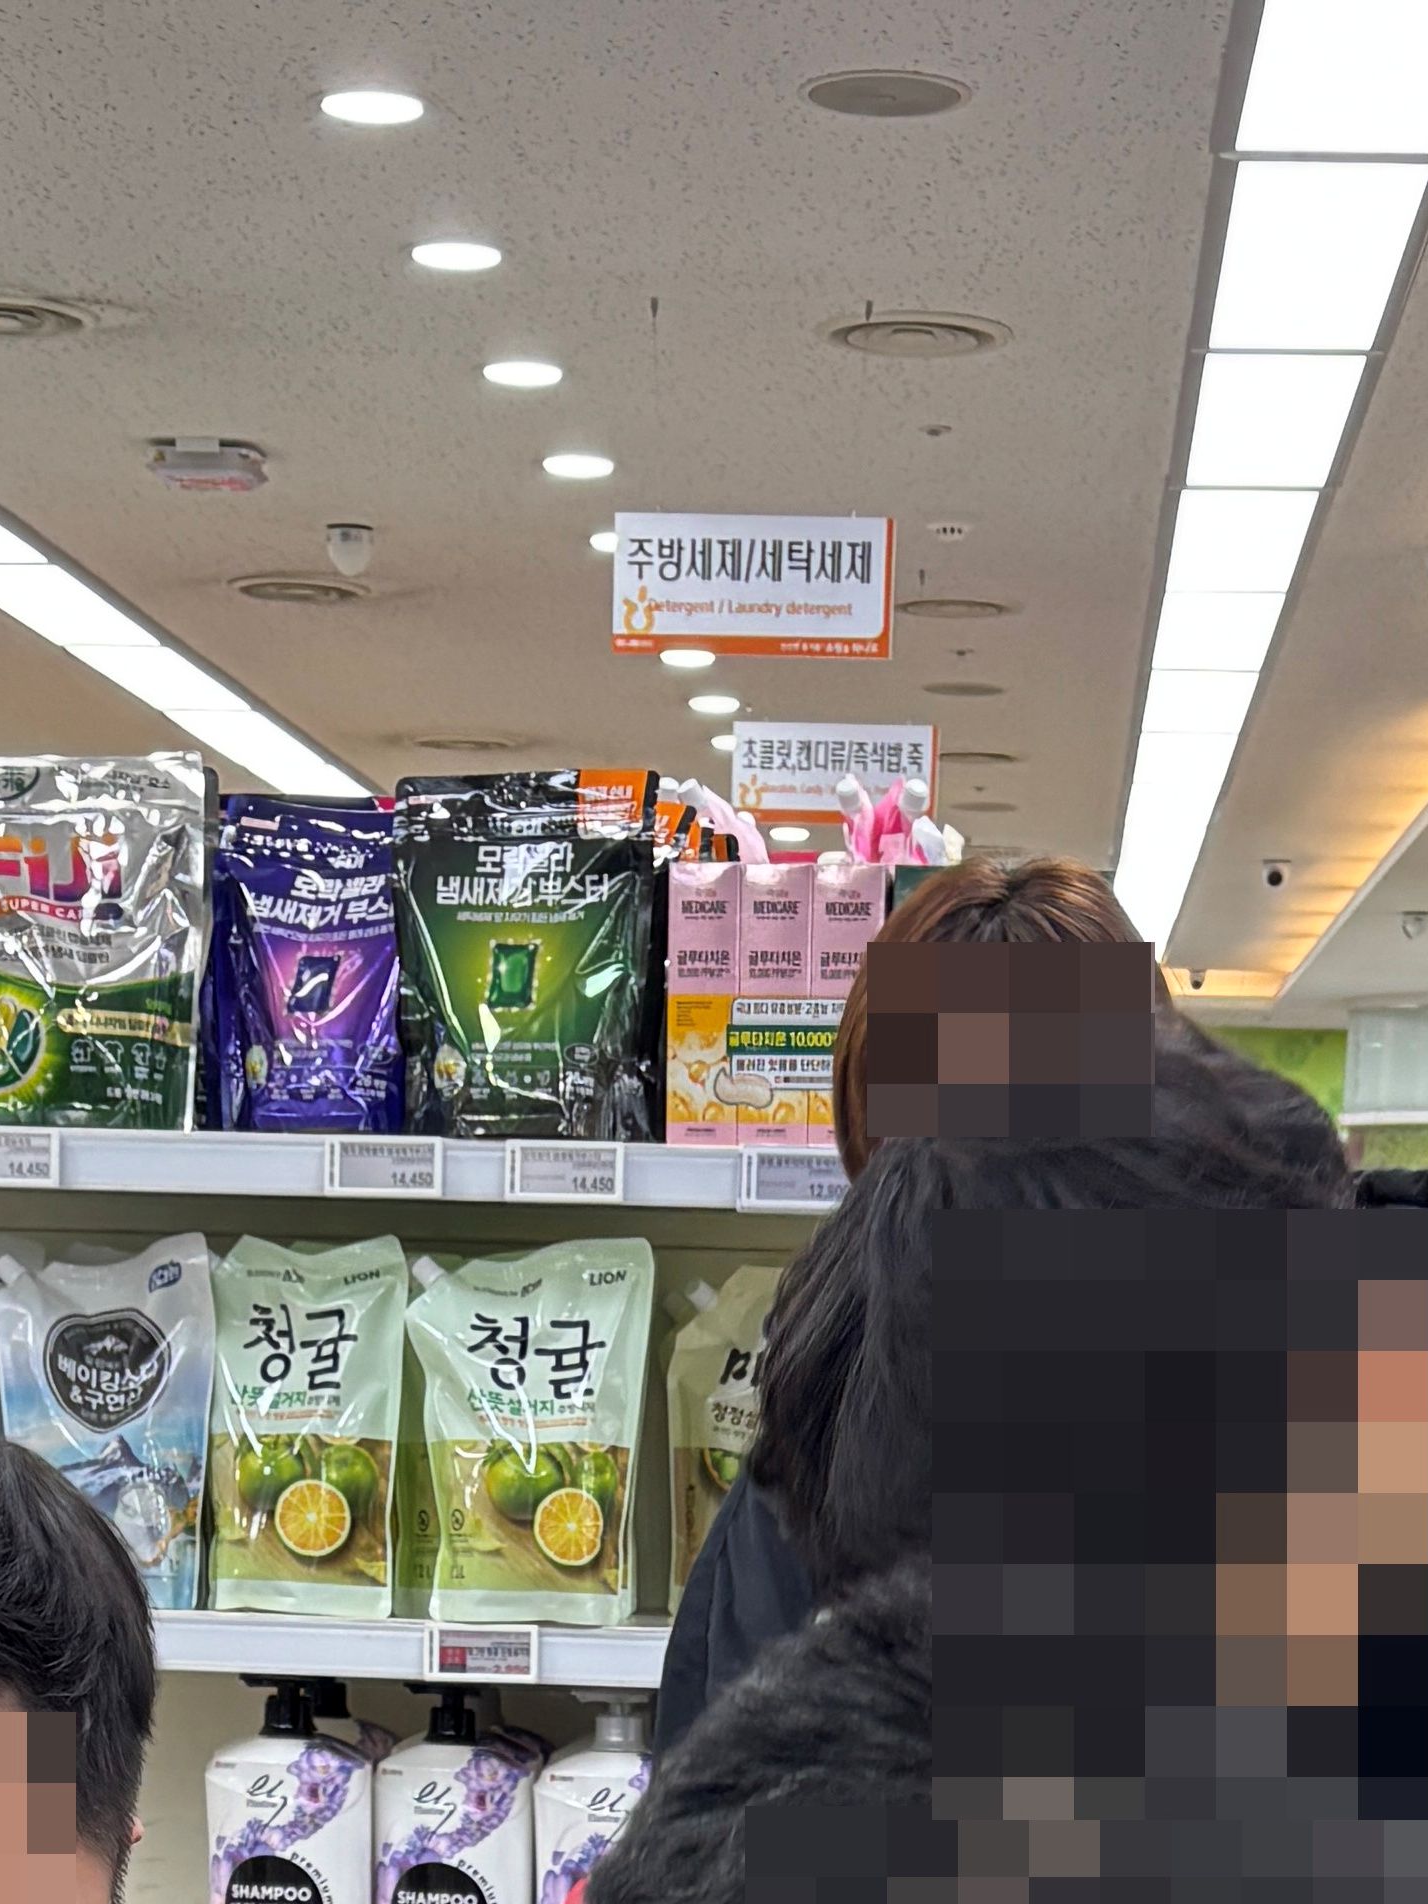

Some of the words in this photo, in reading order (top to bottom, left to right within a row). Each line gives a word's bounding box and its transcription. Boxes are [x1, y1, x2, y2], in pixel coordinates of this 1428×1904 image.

[627, 537, 873, 584] 주방세제/세탁세제
[728, 600, 782, 618] Laundry
[786, 601, 853, 618] detergent
[2, 898, 50, 914] SUPER
[55, 904, 96, 920] CA
[729, 1031, 787, 1048] 글루타치온
[391, 1172, 433, 1187] 14,450
[572, 1177, 615, 1192] 14,450
[344, 1270, 380, 1285] LION
[588, 1270, 627, 1286] LION
[243, 1303, 358, 1391] 청귤
[467, 1313, 607, 1400] 청귤
[231, 1884, 313, 1903] SHAMPOO
